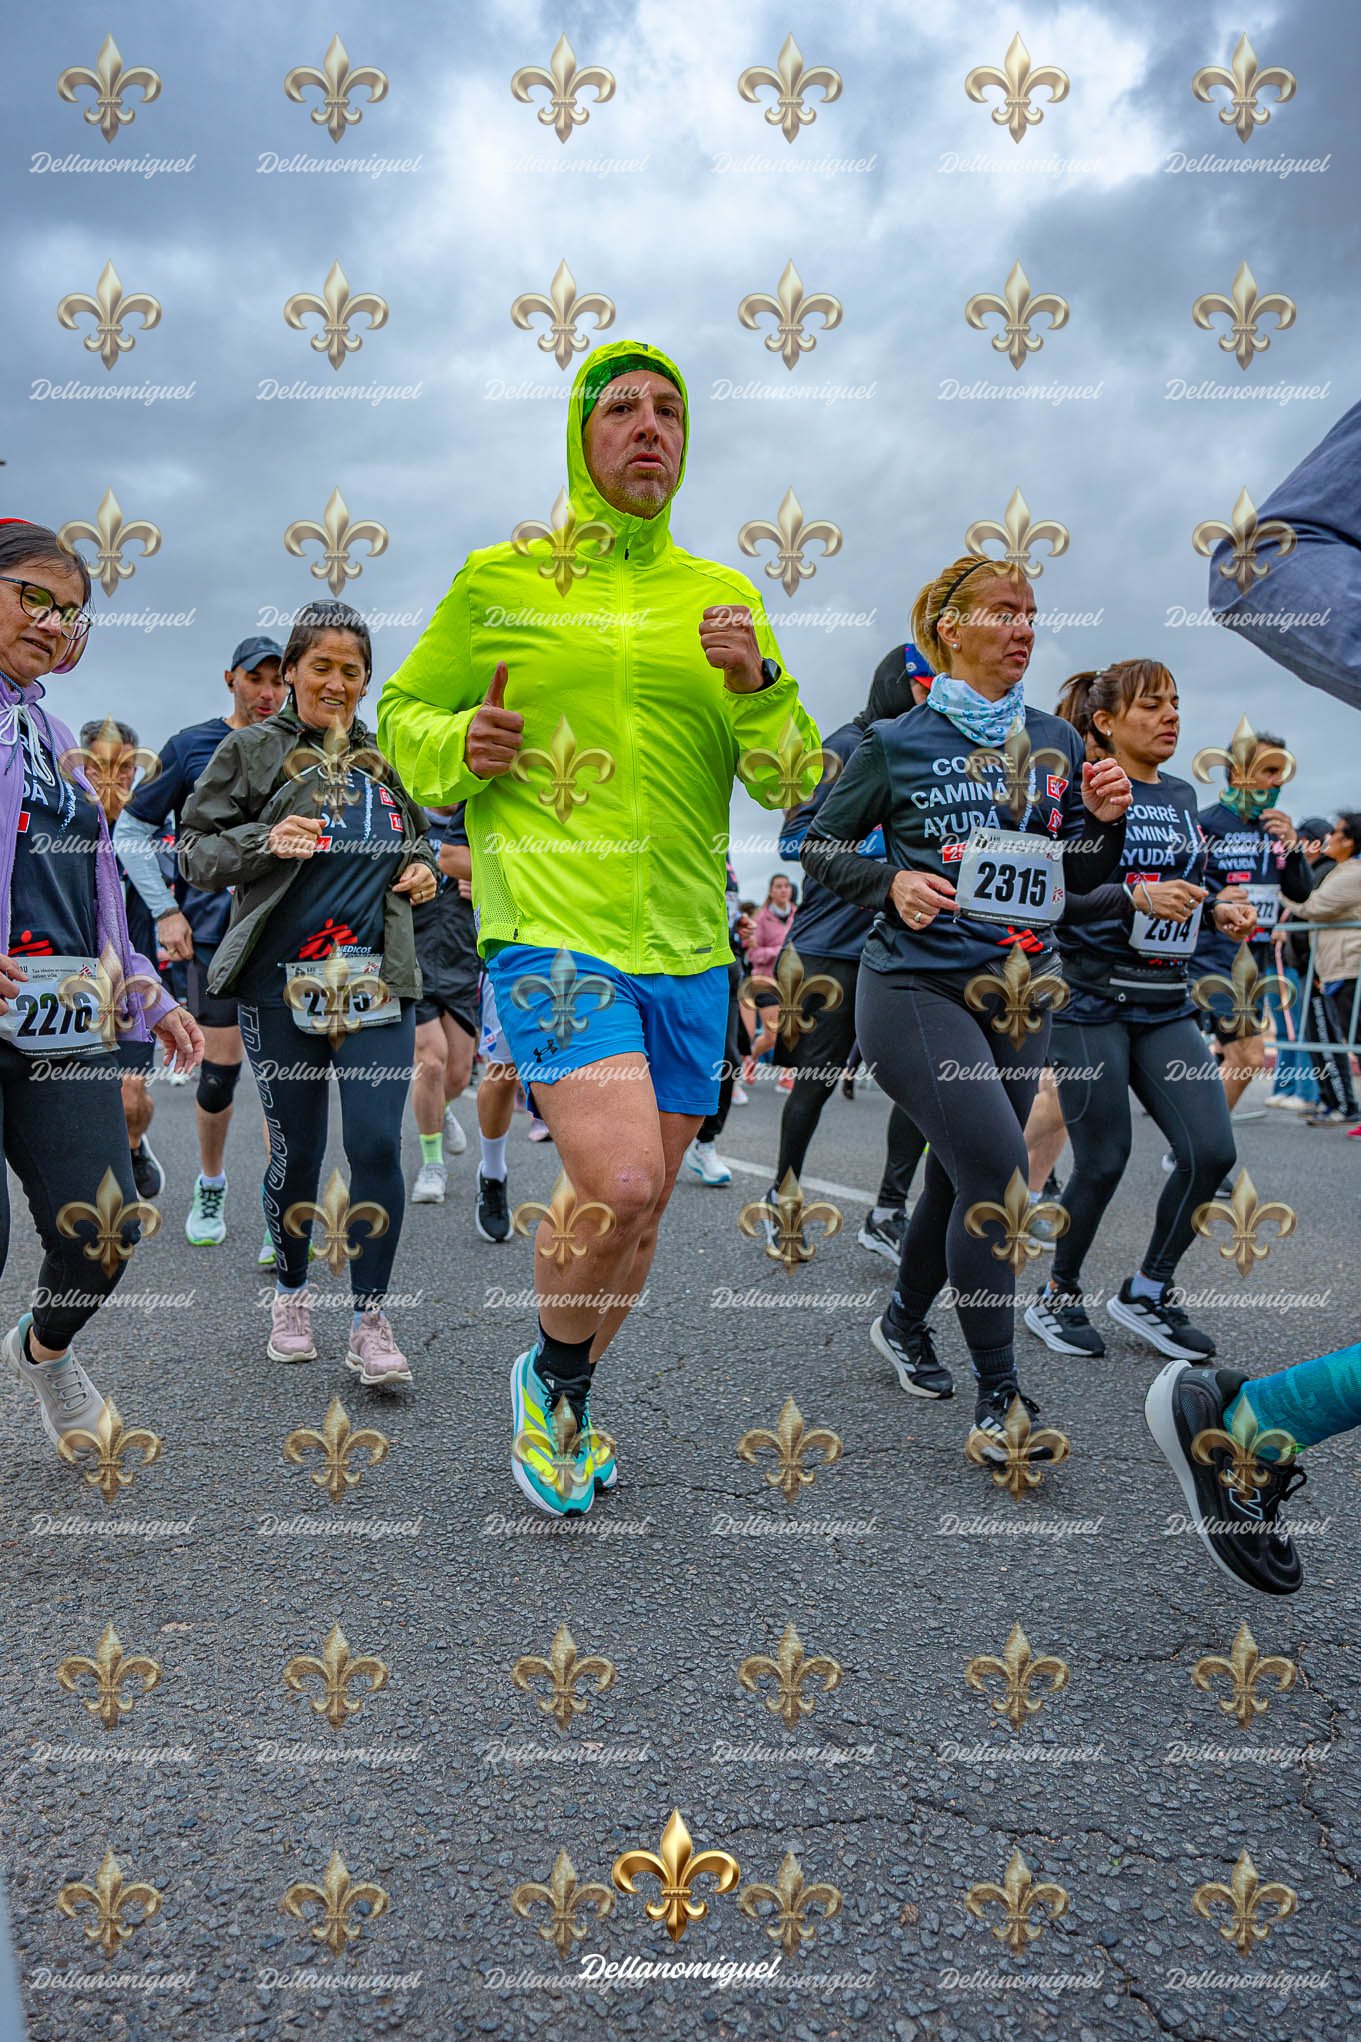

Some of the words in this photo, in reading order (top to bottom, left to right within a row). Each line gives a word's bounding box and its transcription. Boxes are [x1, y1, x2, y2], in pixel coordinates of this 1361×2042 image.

[932, 753, 1016, 776] CORRÉ
[911, 778, 1010, 809] CAMINÁ
[924, 805, 1000, 838] AYUDÁ
[1125, 825, 1182, 843] AMINÁ
[974, 861, 1048, 907] 2315
[1144, 913, 1193, 942] 2314
[16, 992, 92, 1037] 2276
